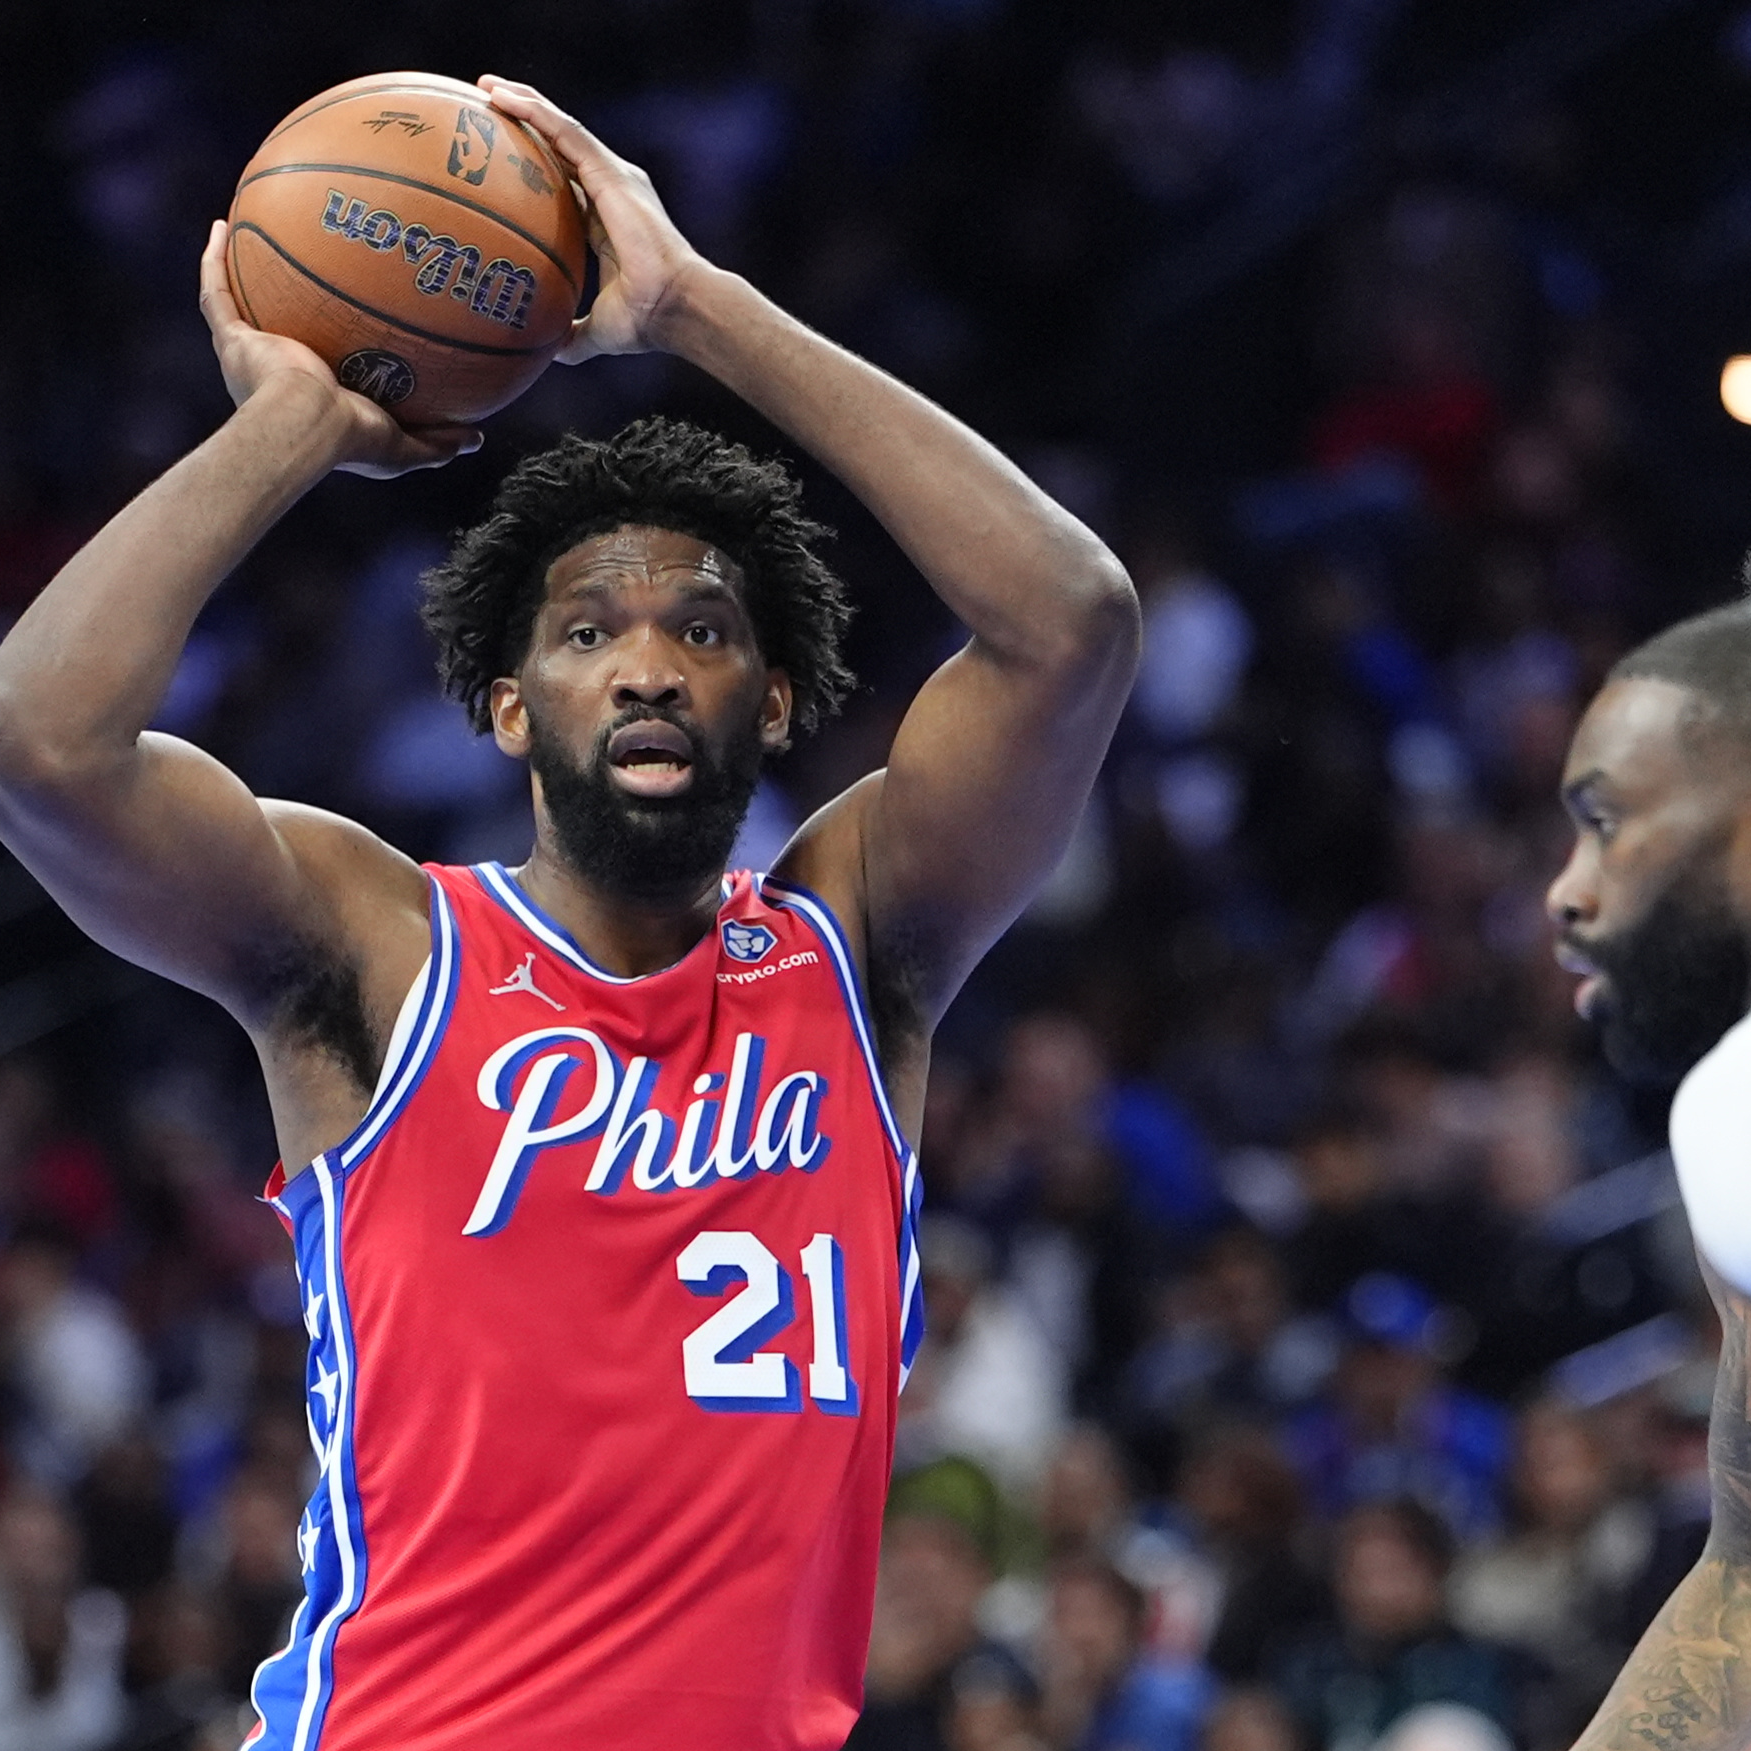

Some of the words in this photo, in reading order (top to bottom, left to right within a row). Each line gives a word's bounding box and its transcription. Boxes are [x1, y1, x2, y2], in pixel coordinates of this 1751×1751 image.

[320, 188, 536, 331] Wilson
[716, 951, 819, 985] crypto.com
[462, 1027, 829, 1238] Phila
[676, 1231, 859, 1417] 21
